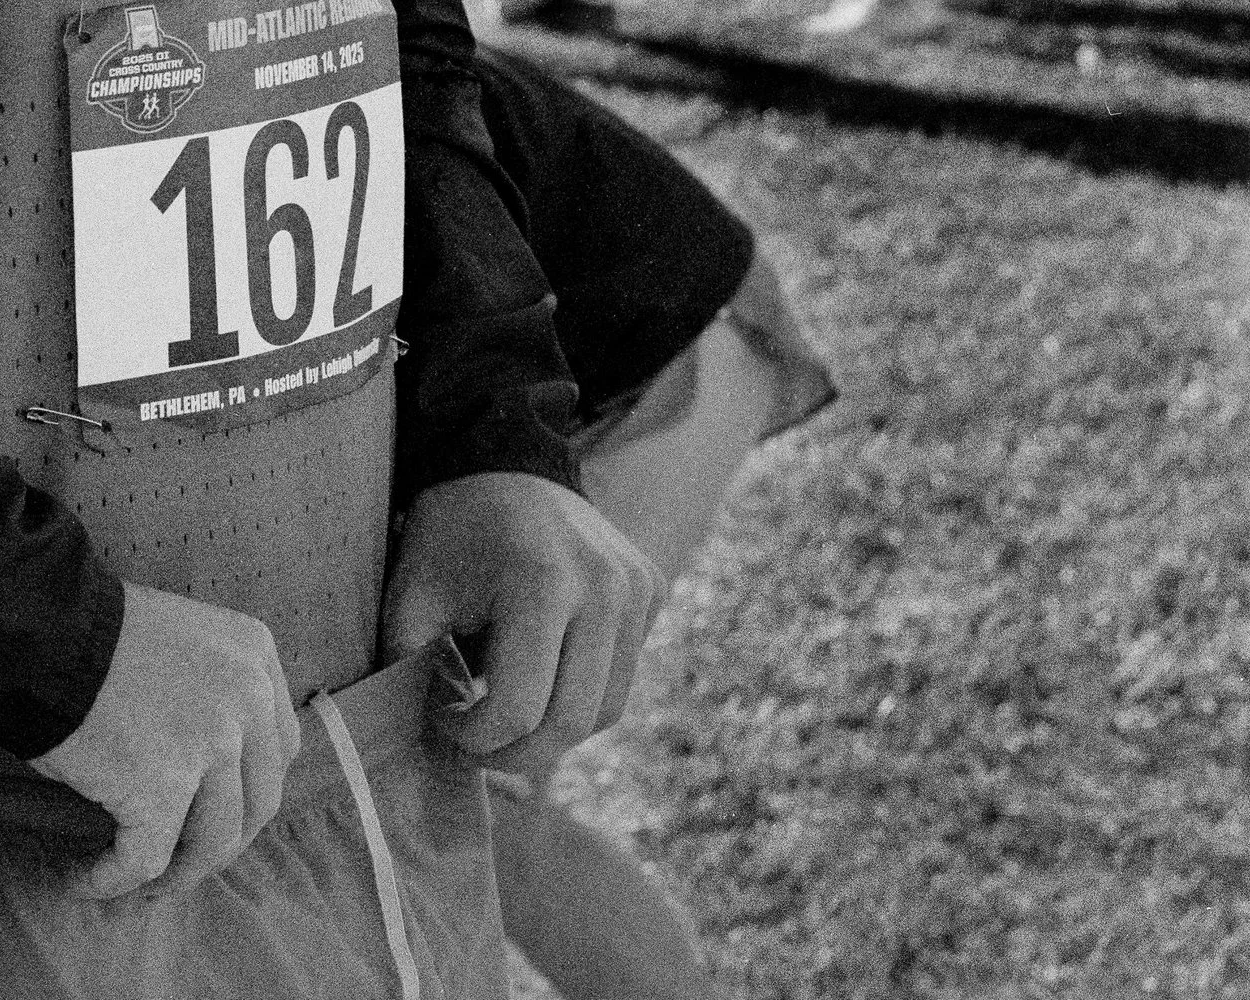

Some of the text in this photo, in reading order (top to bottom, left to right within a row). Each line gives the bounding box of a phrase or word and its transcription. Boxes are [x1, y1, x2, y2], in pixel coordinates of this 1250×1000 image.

[207, 0, 328, 52] MID-ATLANTIC
[91, 67, 202, 98] CHAMPIONSHIPS
[109, 58, 184, 78] CROSS COUNTRY
[121, 53, 154, 66] 2025
[254, 41, 365, 90] NOVEMBER 14, 2025
[150, 101, 373, 368] 162
[139, 353, 353, 422] BETHLEHEM, PA Hosted by Lehigh
